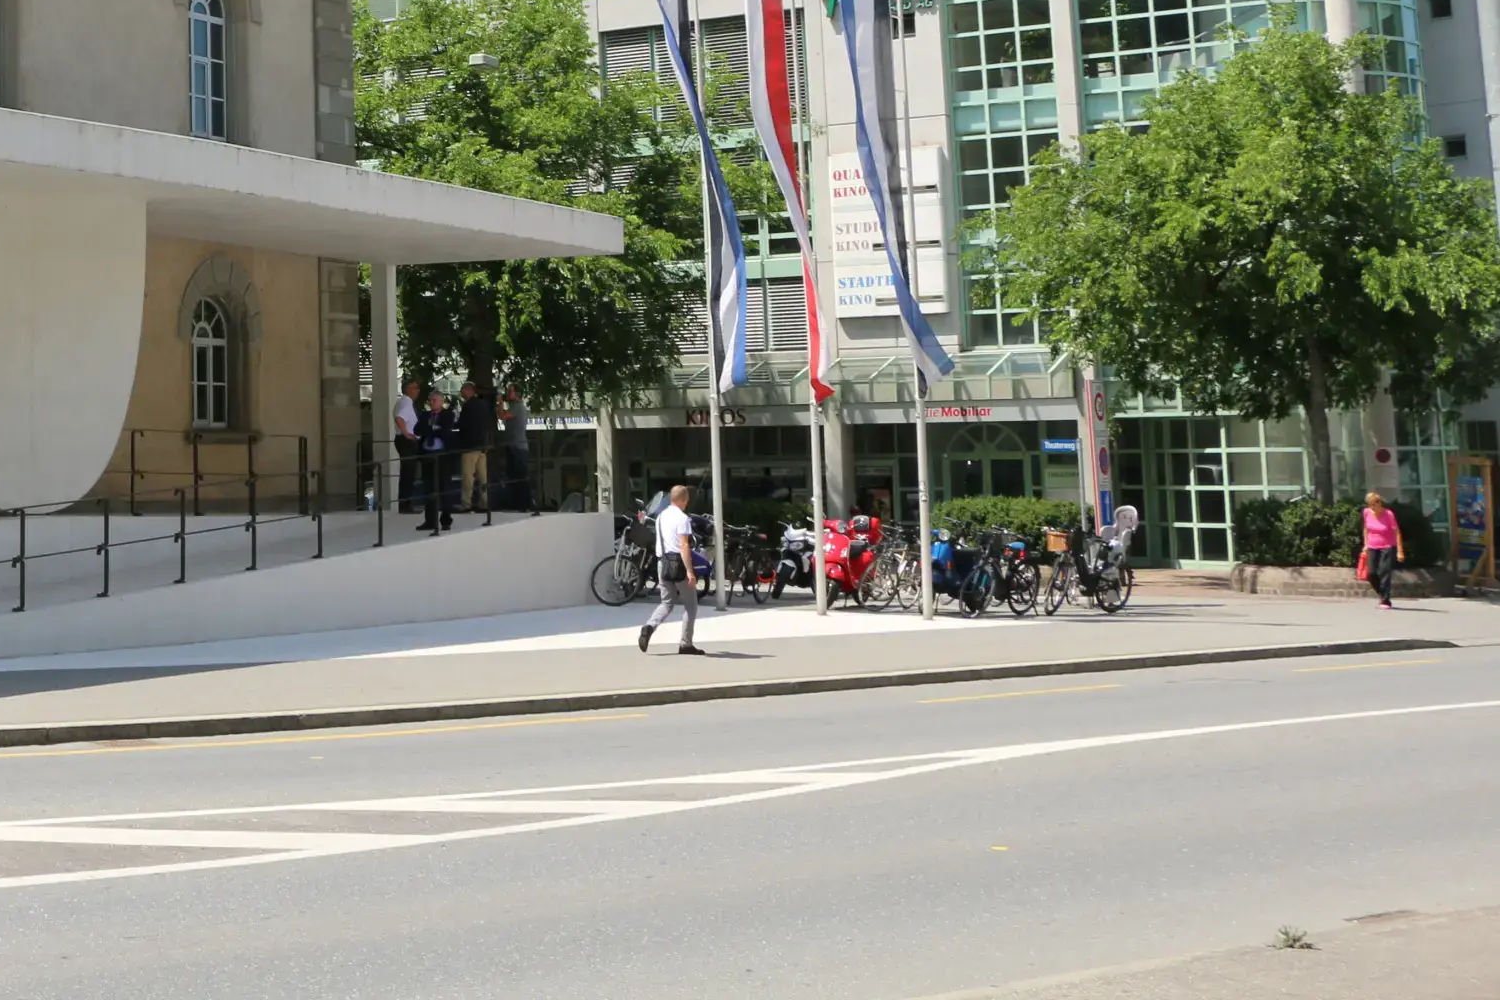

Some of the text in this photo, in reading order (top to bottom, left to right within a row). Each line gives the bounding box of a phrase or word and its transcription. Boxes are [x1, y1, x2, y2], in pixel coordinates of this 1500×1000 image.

[832, 168, 862, 181] QUA
[833, 185, 867, 198] KINO
[835, 221, 879, 235] STUDI
[836, 240, 870, 252] KINO
[838, 274, 895, 289] STADTH
[838, 294, 873, 306] KINO
[941, 405, 992, 417] Mobiliar
